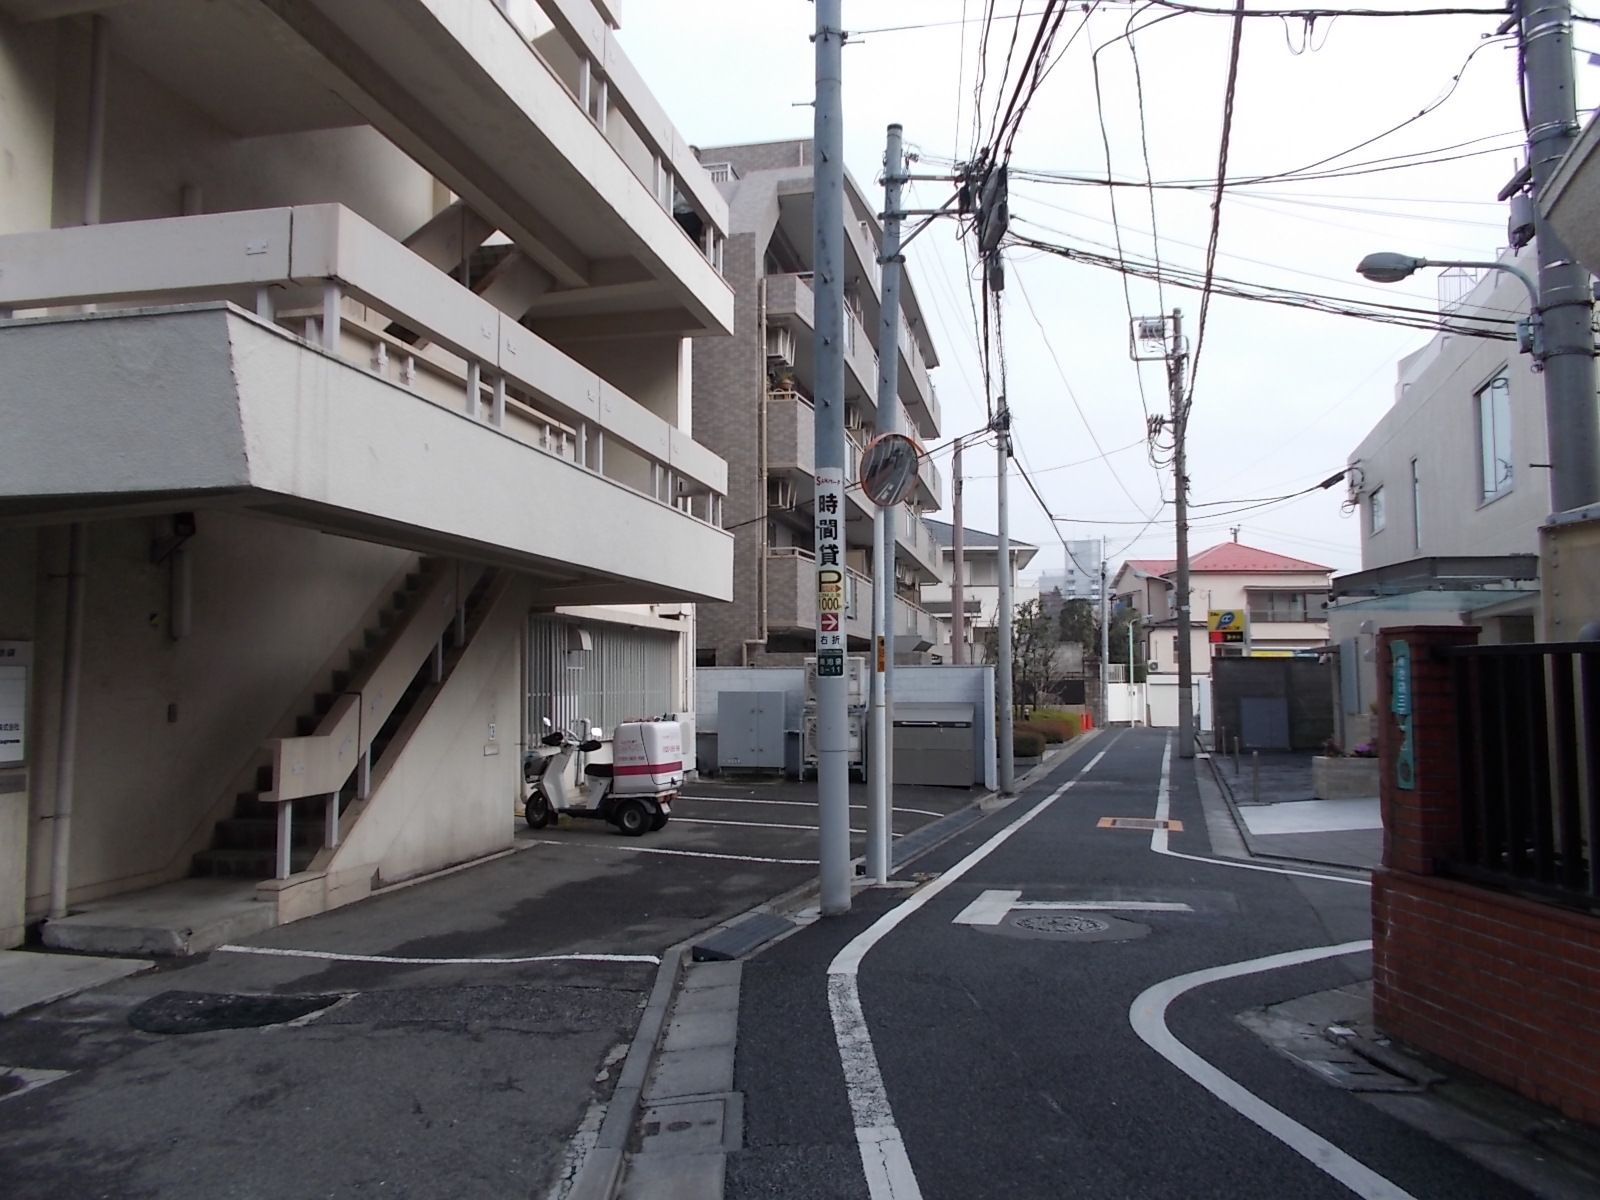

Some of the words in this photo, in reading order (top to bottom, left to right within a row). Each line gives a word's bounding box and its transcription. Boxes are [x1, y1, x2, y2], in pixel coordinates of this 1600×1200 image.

[819, 493, 839, 566] 時間貸
[821, 636, 840, 645] 右折
